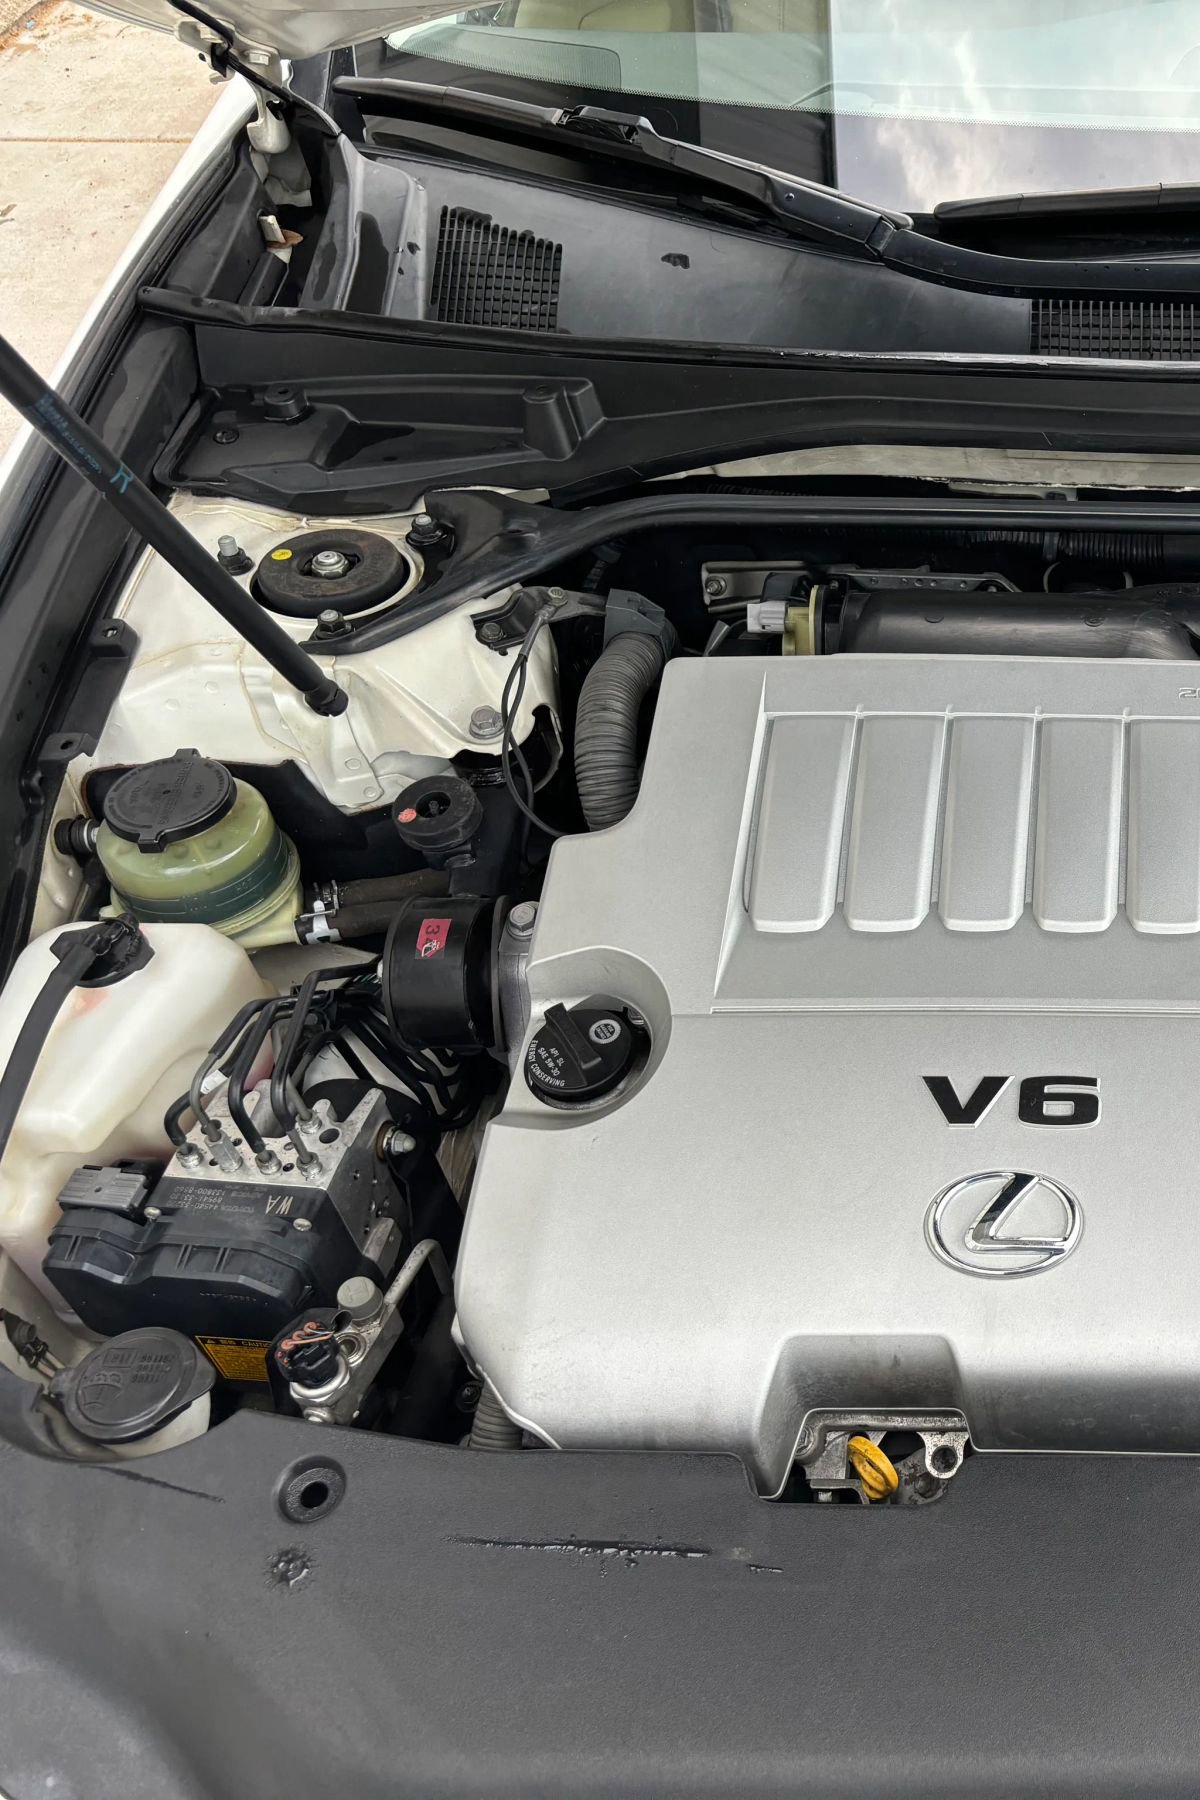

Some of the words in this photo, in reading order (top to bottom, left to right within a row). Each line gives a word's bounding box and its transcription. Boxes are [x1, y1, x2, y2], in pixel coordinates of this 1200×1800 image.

[528, 1040, 539, 1063] ENERGY
[537, 1047, 547, 1059] SAE
[544, 1058, 561, 1077] 5W-30
[549, 1047, 559, 1058] API
[556, 1057, 565, 1067] SL
[530, 1063, 565, 1087] CONSERVING
[921, 1073, 1103, 1130] V6
[265, 1195, 294, 1215] WA
